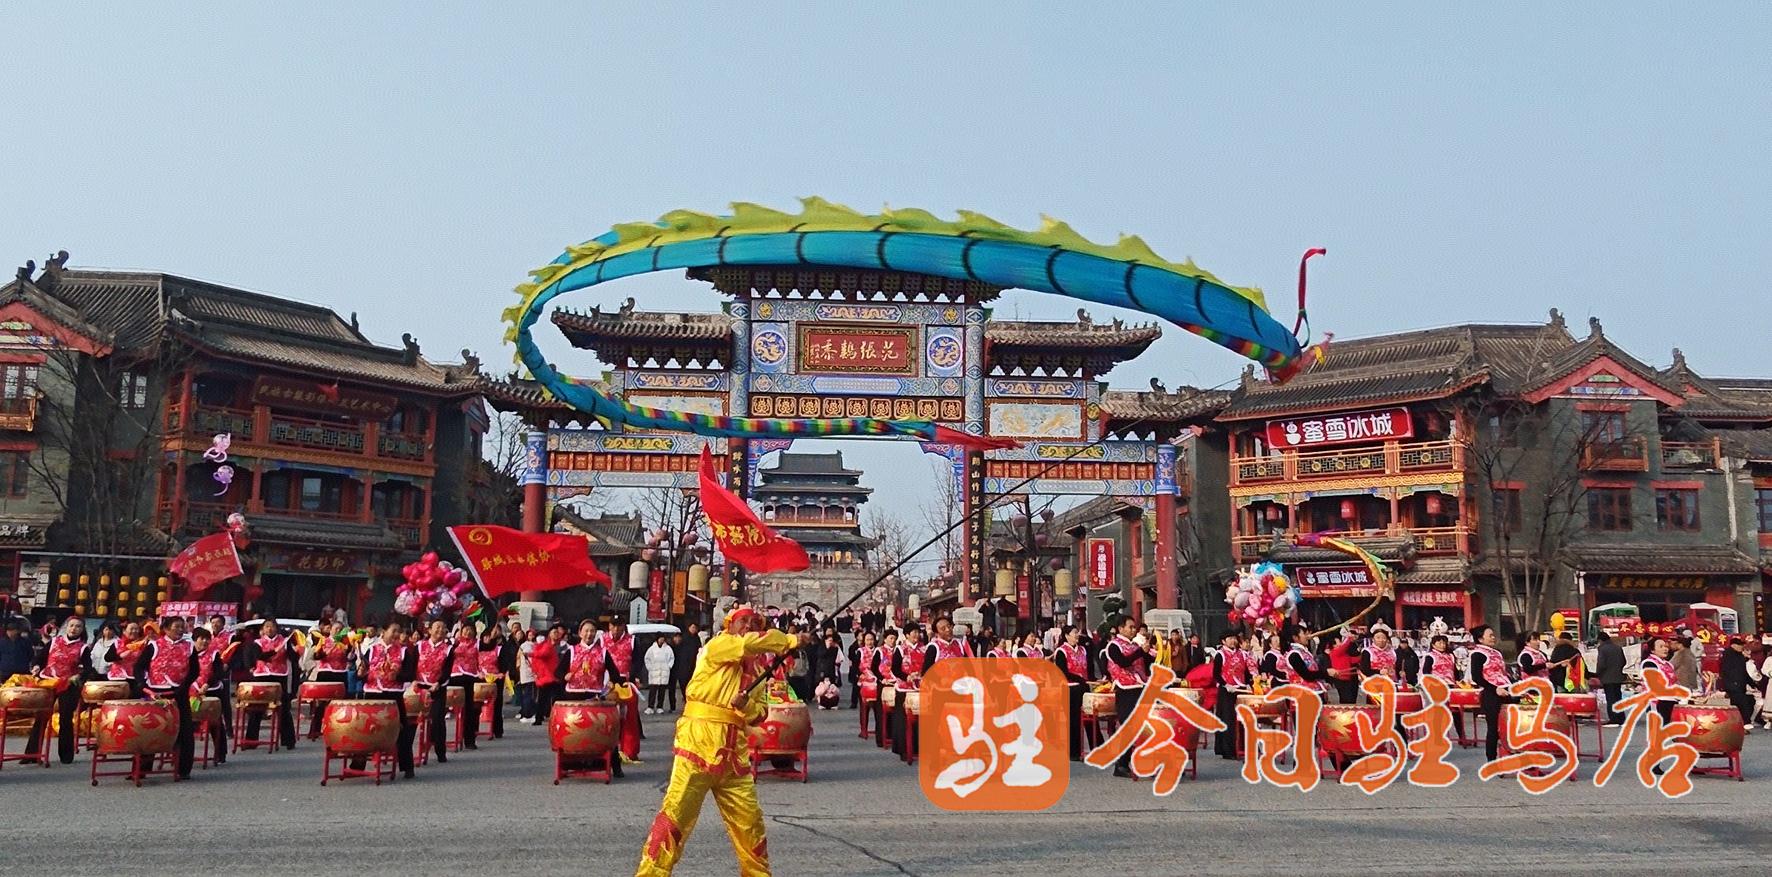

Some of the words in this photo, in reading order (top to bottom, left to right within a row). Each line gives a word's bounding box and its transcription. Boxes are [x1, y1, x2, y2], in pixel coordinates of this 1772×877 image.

[1302, 412, 1394, 443] 蜜雪冰城
[1315, 570, 1368, 584] 蜜雪冰城
[1619, 621, 1675, 634] 不忘初心
